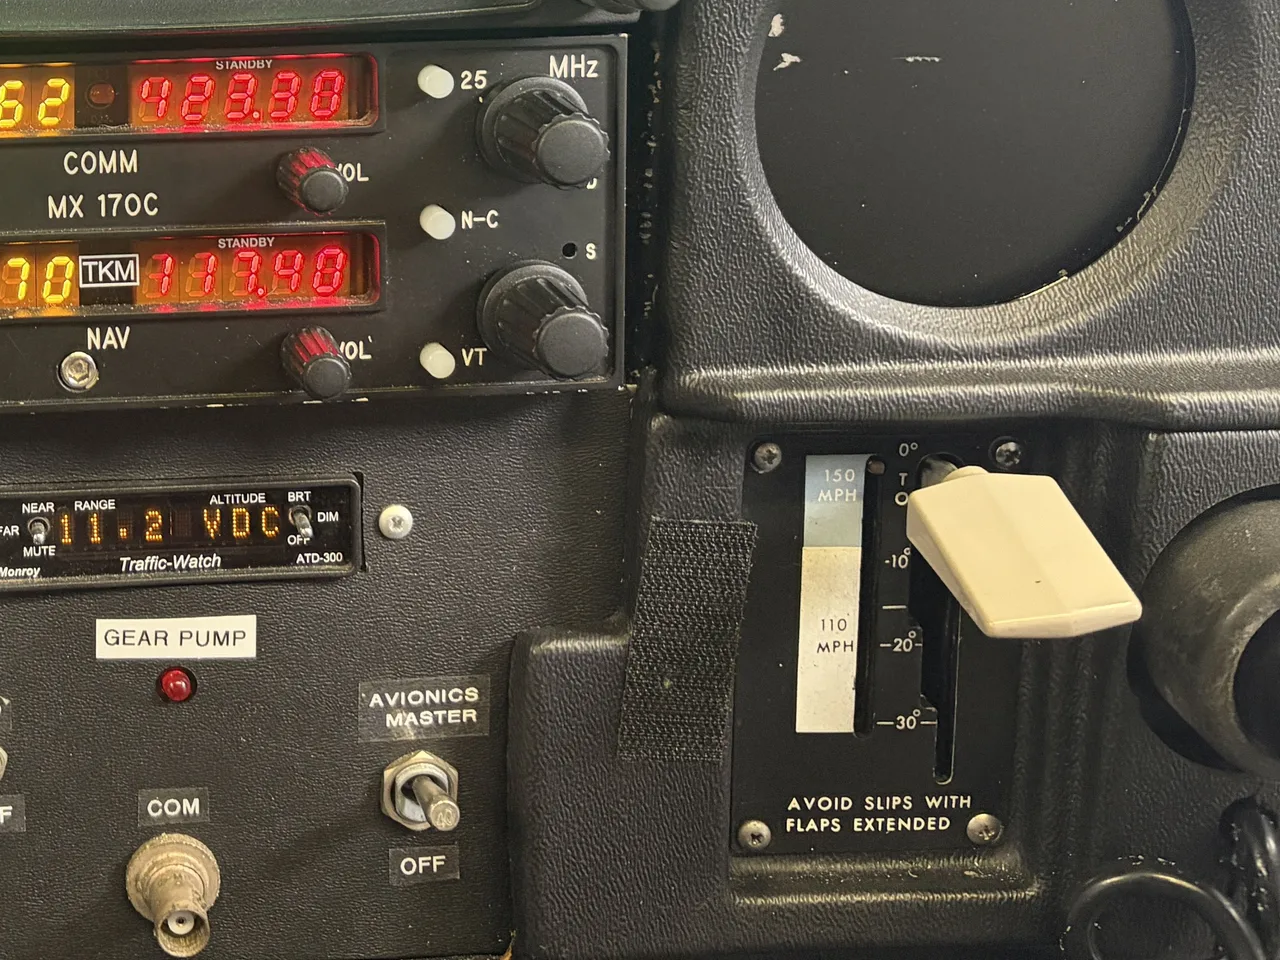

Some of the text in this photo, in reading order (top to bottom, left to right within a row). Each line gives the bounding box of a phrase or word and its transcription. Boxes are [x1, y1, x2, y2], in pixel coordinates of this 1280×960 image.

[549, 54, 598, 79] MHz
[462, 71, 486, 89] 25
[64, 151, 137, 174] COMM
[48, 195, 83, 218] MX
[462, 211, 498, 228] N-C
[218, 237, 274, 248] STANDBY
[83, 260, 134, 283] TKM
[87, 328, 130, 349] NAV
[824, 469, 854, 482] 150
[210, 493, 266, 504] ALTITUDE
[288, 491, 311, 502] BRT
[818, 488, 857, 502] MPH
[22, 502, 54, 513] NEAR
[74, 500, 116, 510] RANGE
[318, 512, 338, 522] DIM
[61, 507, 279, 544] 11.2 VDC
[23, 546, 56, 557] MUTE
[296, 552, 342, 564] ATD-300
[120, 554, 221, 571] Traffic-Watch
[820, 618, 847, 631] 110
[104, 629, 246, 647] GEAR PUMP
[817, 640, 853, 653] MPH
[369, 686, 479, 706] AVIONICS
[385, 706, 478, 725] MASTER
[147, 797, 200, 817] COM
[788, 796, 972, 810] AVOID SLIPS WITH
[786, 817, 950, 832] FLAPS EXTENDED
[400, 856, 446, 876] OFF
